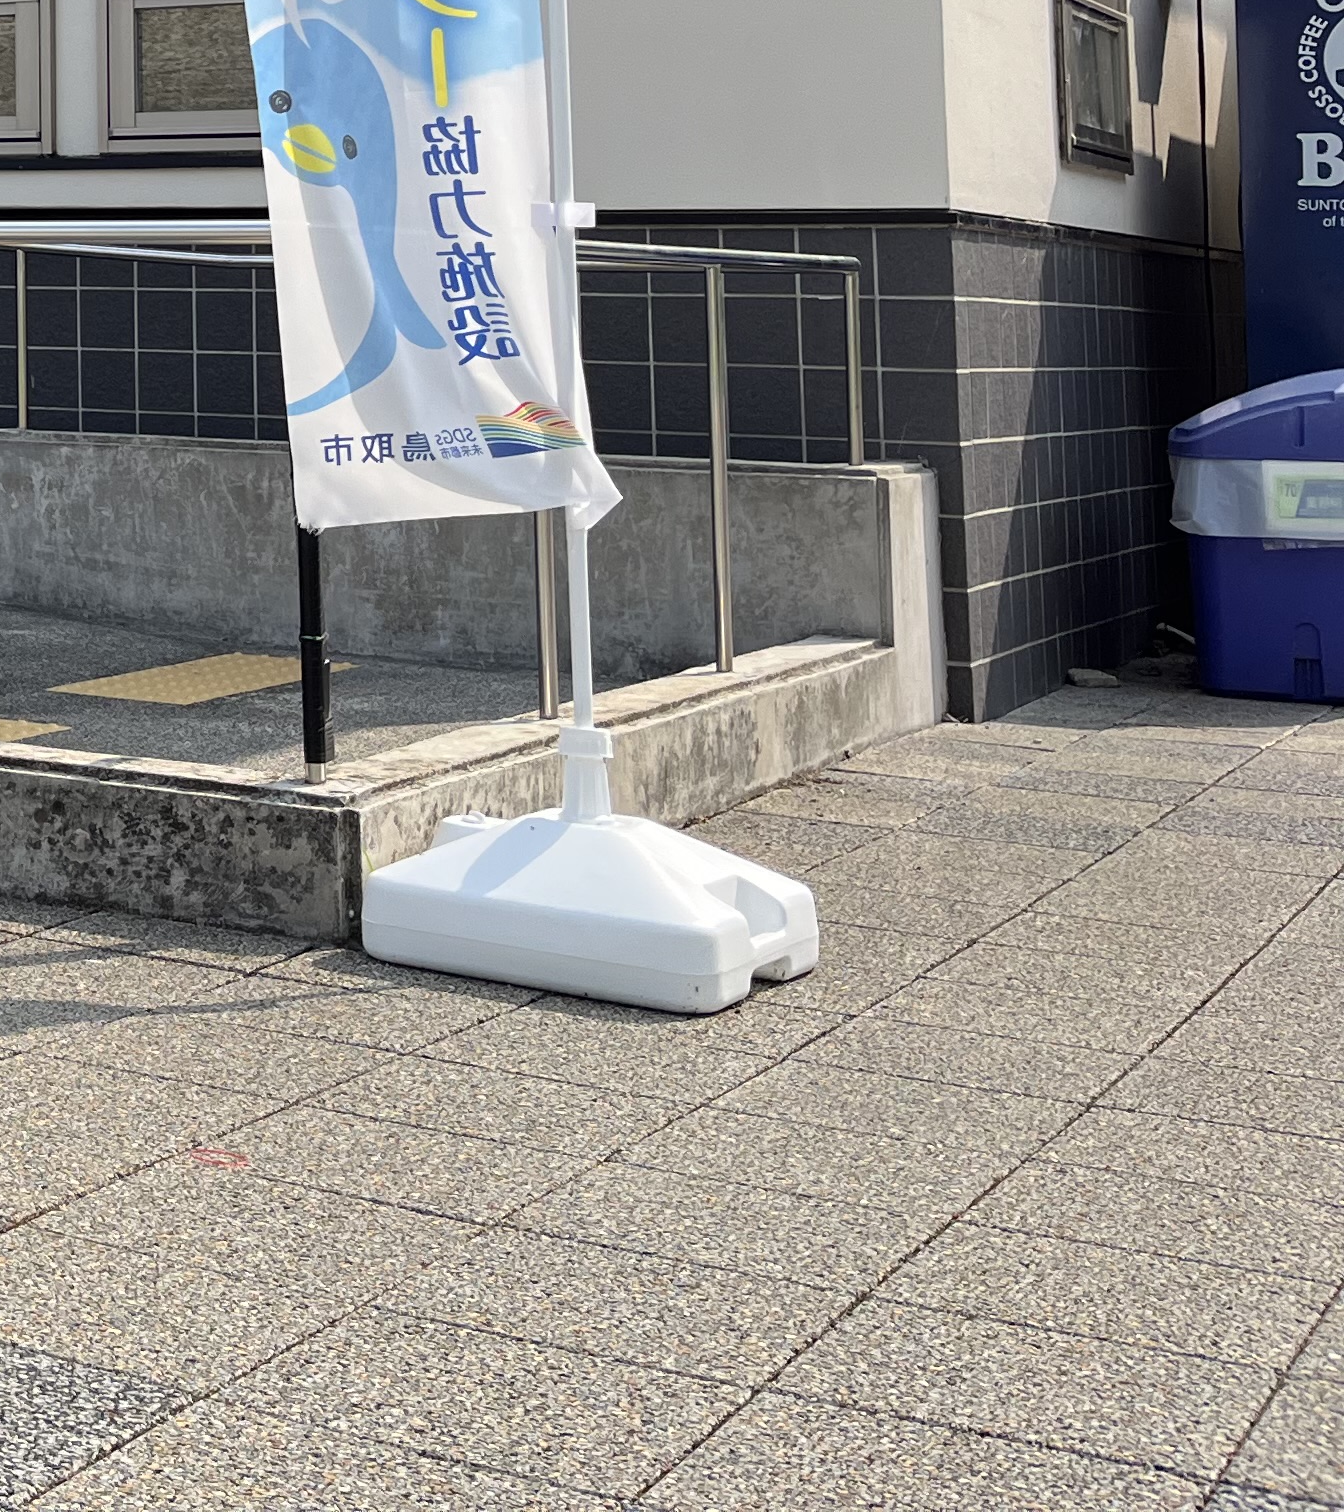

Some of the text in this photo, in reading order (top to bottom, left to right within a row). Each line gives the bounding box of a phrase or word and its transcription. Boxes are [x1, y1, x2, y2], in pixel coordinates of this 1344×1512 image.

[1298, 14, 1344, 127] OSS COFFEE
[1323, 215, 1336, 228] of
